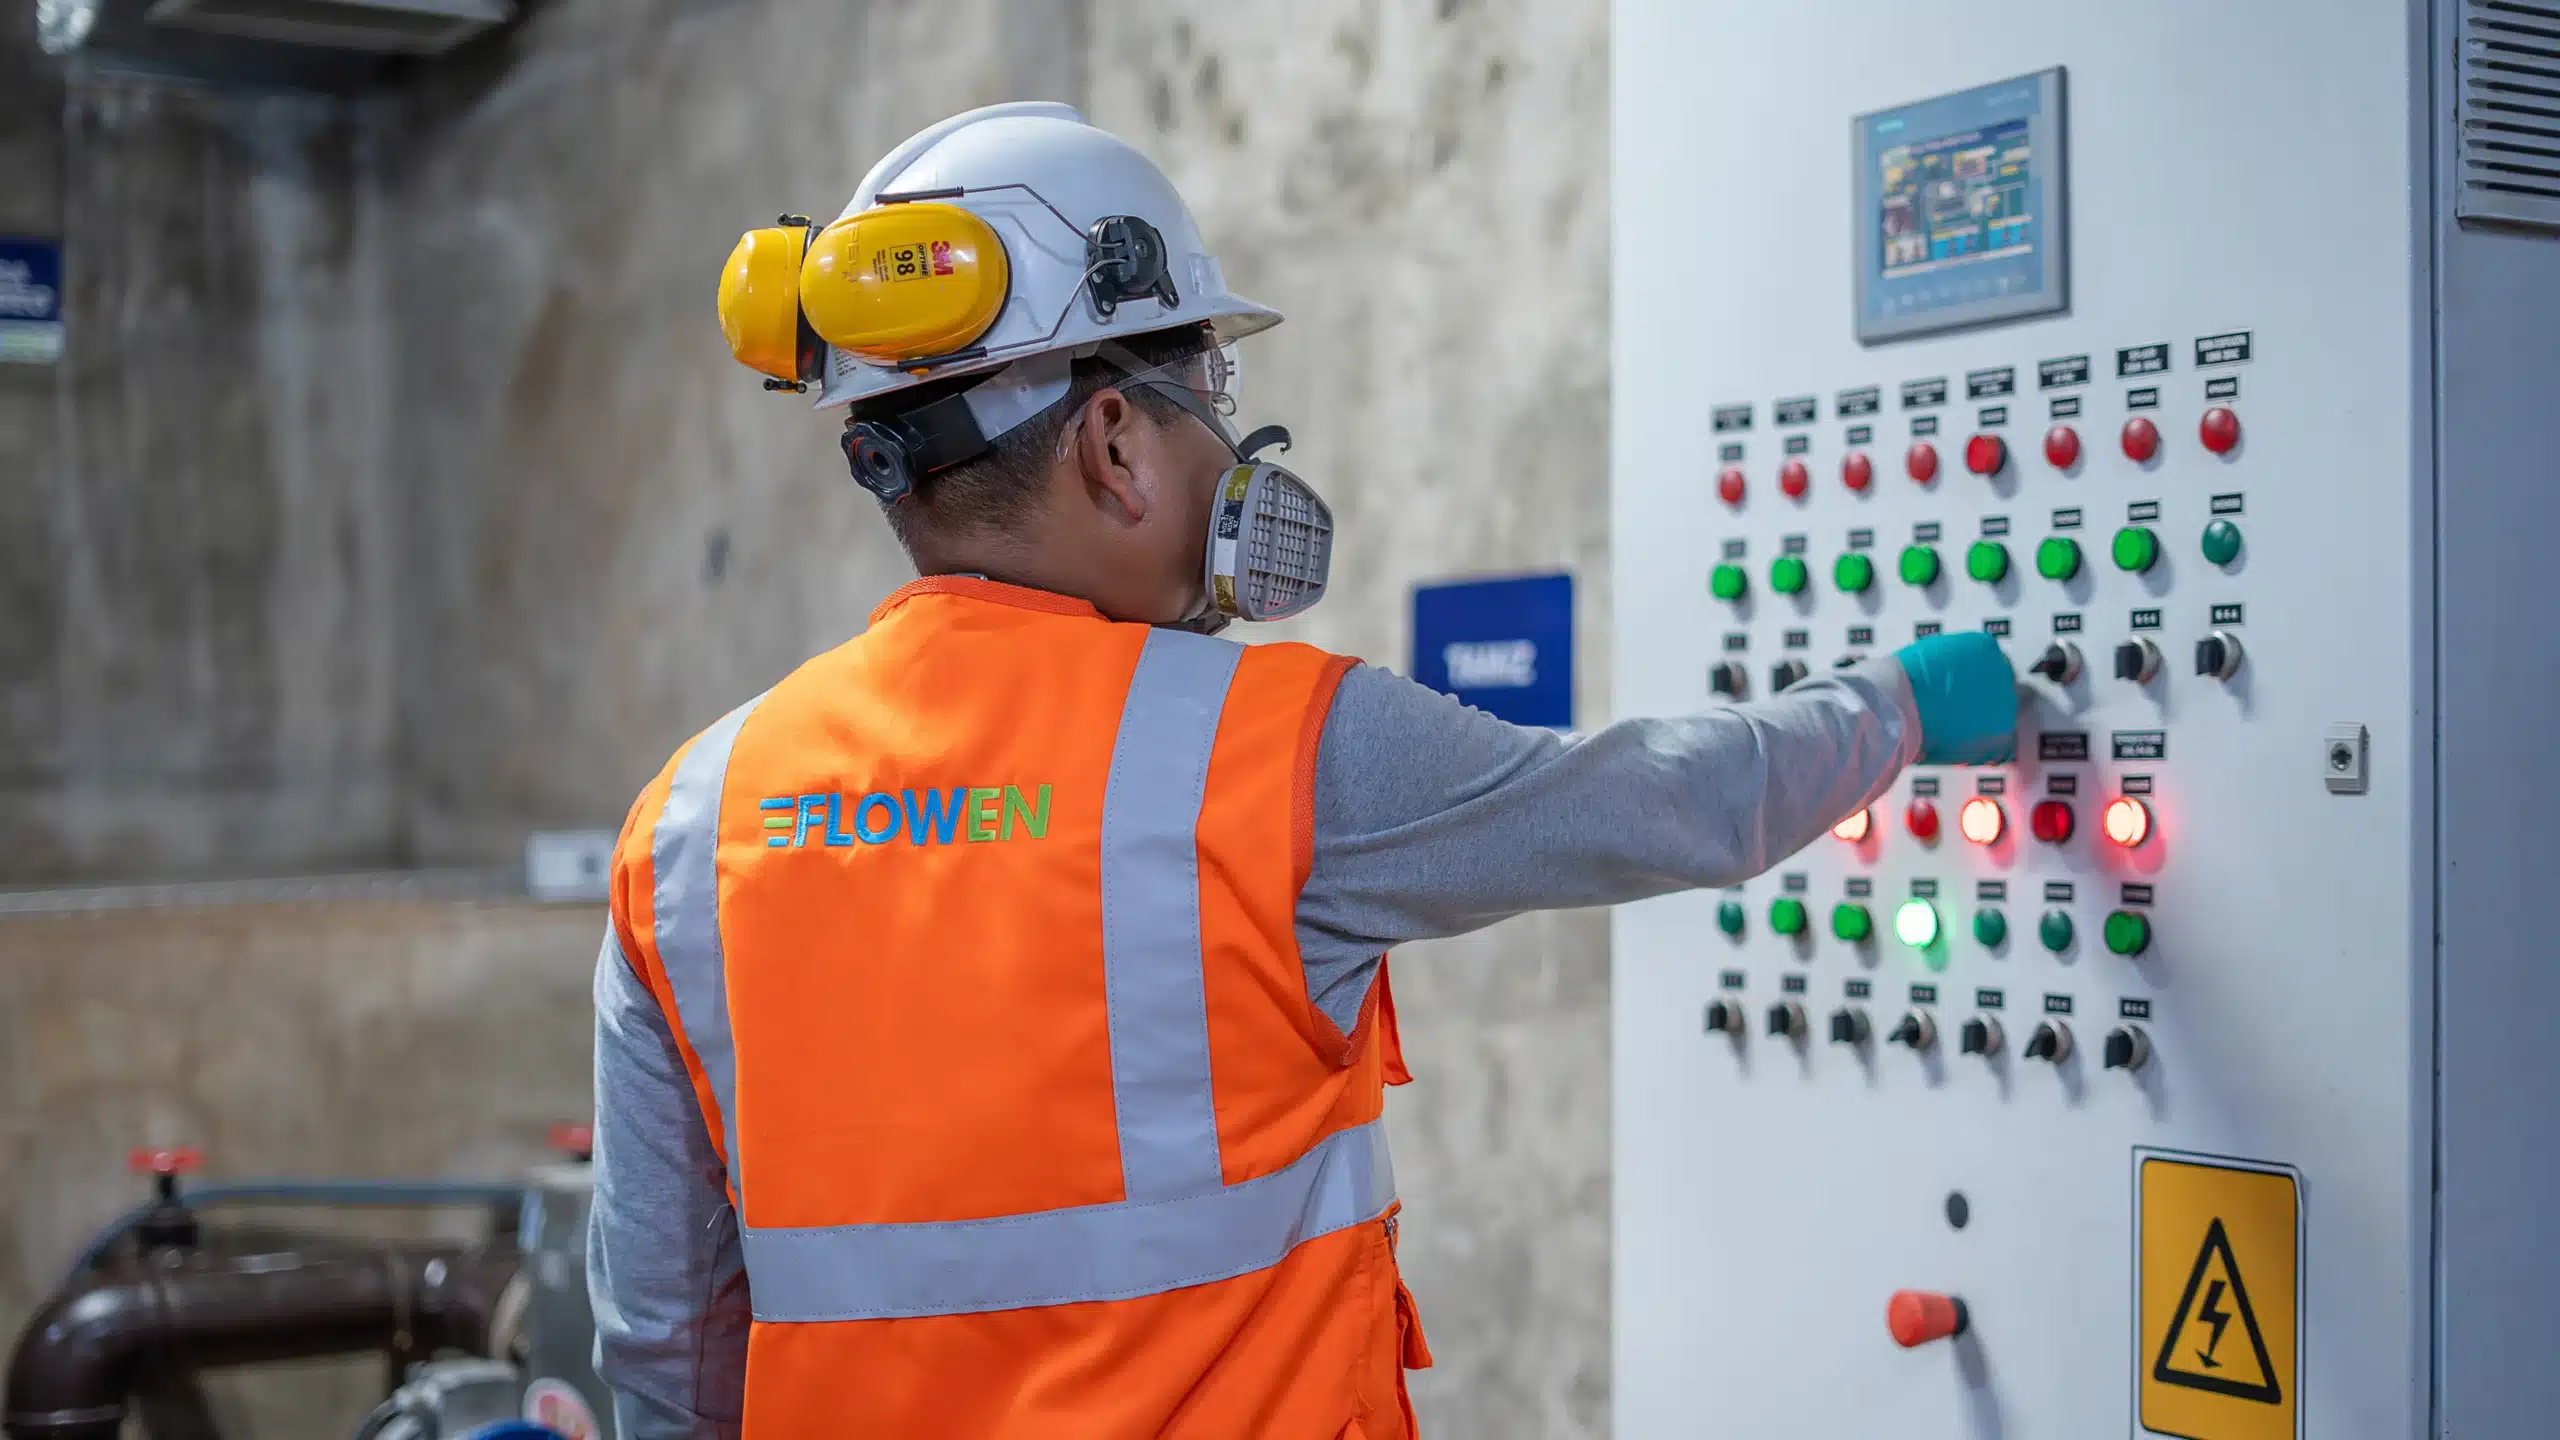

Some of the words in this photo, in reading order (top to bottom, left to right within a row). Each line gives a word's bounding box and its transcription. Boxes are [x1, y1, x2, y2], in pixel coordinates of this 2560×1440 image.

[895, 250, 915, 276] 98
[917, 244, 928, 277] OPTIME
[931, 240, 953, 276] 3M
[793, 784, 1052, 848] FLOWEN
